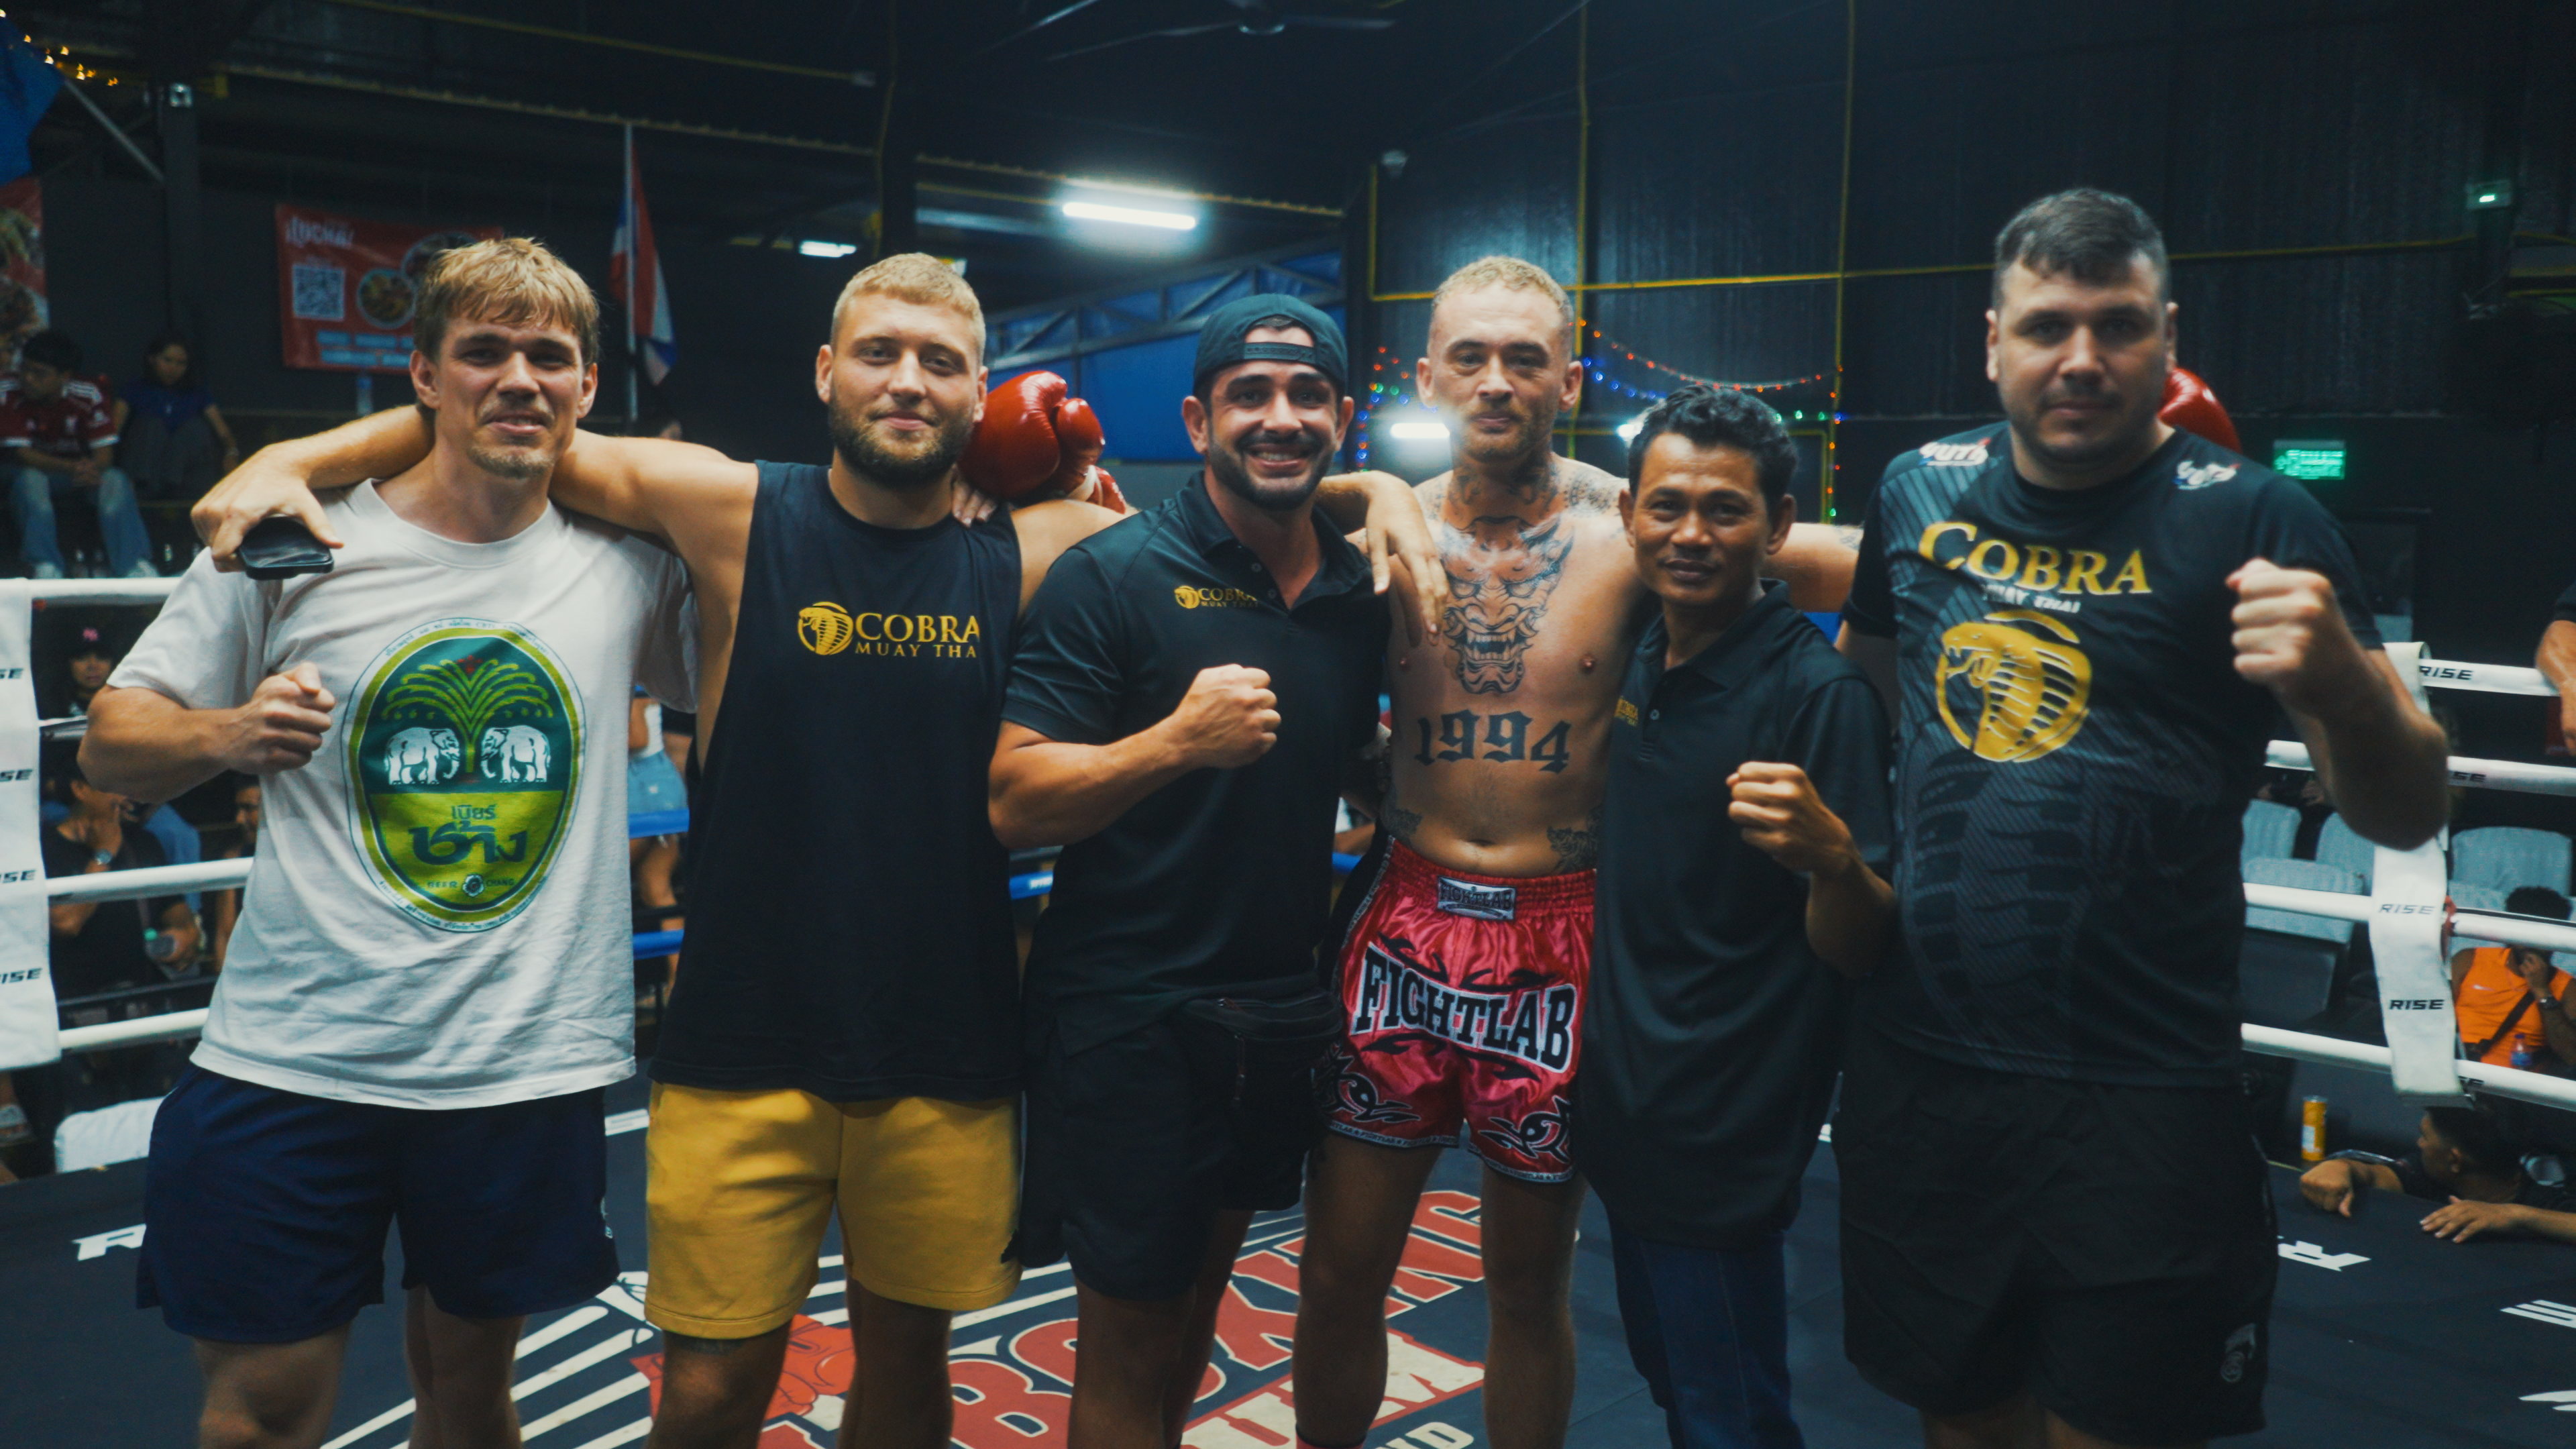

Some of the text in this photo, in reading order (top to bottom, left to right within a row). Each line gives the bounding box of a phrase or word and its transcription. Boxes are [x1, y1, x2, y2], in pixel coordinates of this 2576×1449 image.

[1919, 522, 2152, 595] COBRA
[855, 612, 980, 643] COBRA
[855, 641, 977, 658] MUAY THA
[2418, 665, 2473, 681] RISE
[1414, 709, 1572, 774] 1994
[0, 768, 34, 783] SE
[2450, 771, 2487, 784] SE
[408, 820, 528, 865] ช้าง
[0, 869, 37, 883] SE
[2379, 904, 2436, 915] RISE
[0, 967, 42, 984] ISE
[1352, 943, 1576, 1073] FIGHTLAB
[2389, 999, 2445, 1010] RISE
